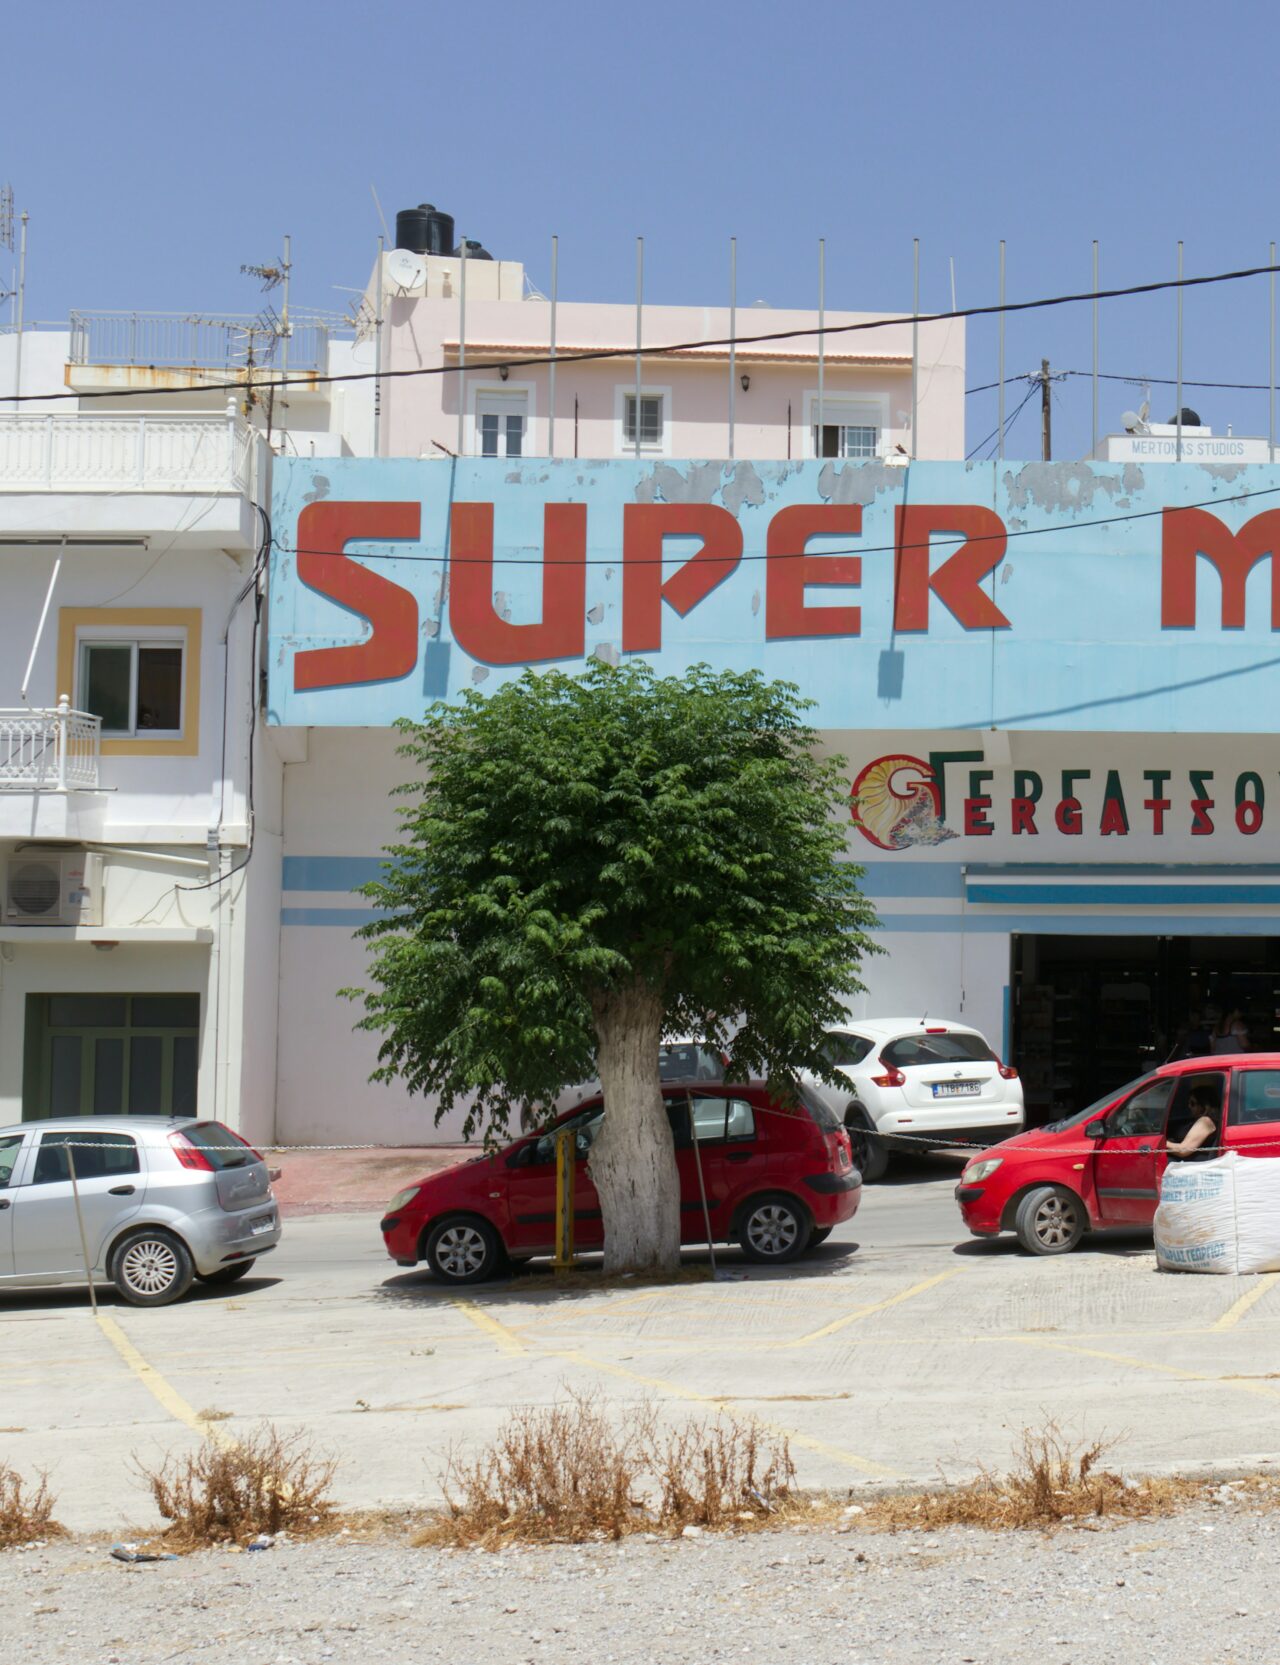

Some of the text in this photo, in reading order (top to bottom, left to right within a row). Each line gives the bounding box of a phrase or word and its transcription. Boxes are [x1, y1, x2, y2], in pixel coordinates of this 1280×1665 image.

[1131, 440, 1245, 456] MERTONAS STUDIOS
[293, 500, 1013, 692] SUPER
[1186, 1243, 1226, 1261] ΓΕΩΡΓΙΟΣ
